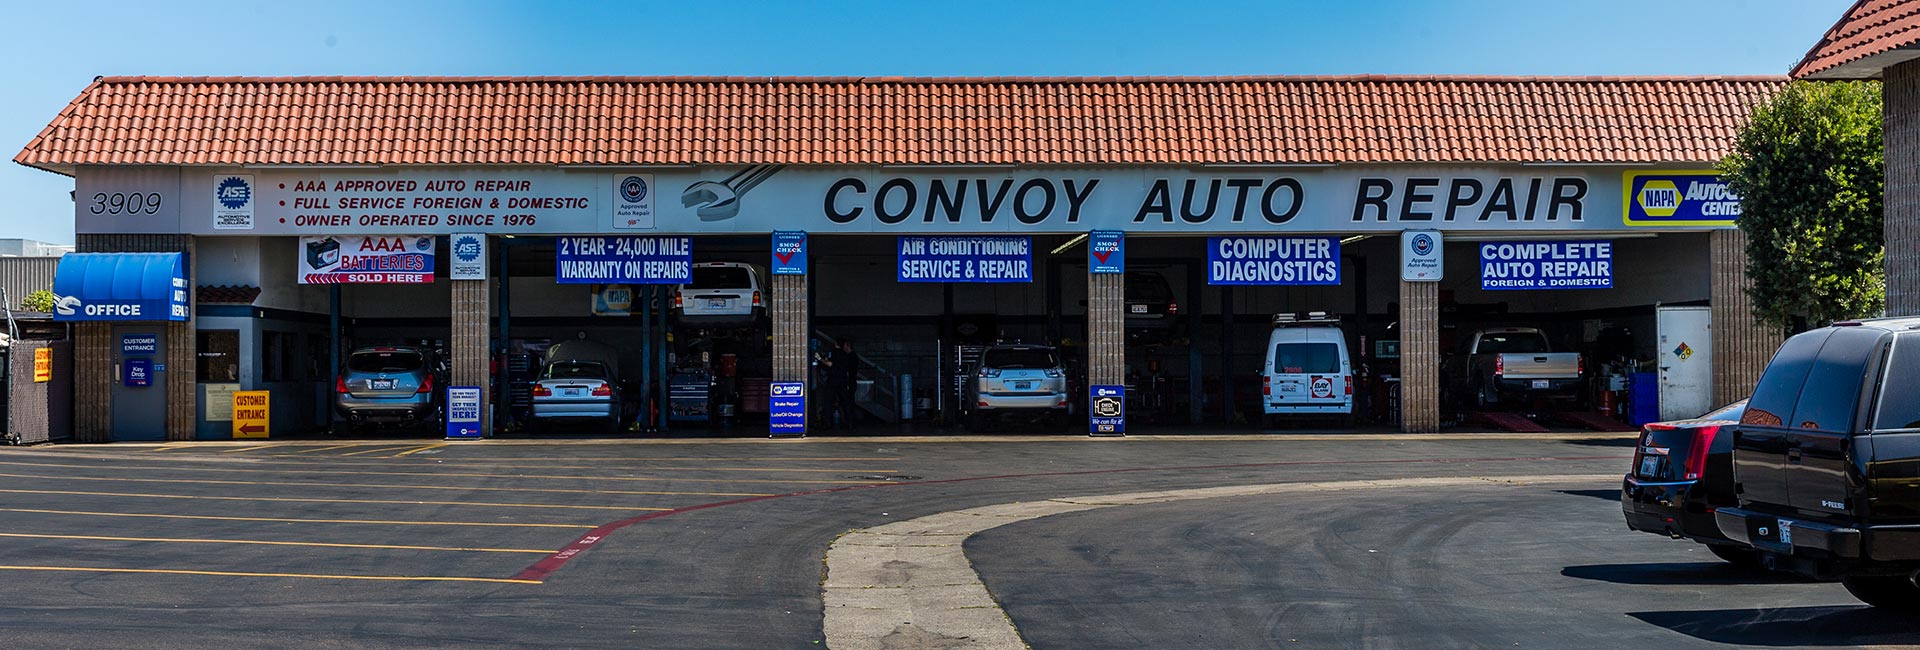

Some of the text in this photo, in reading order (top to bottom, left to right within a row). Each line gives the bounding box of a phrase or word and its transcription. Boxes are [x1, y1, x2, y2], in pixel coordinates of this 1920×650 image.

[221, 186, 246, 198] ASE
[294, 180, 531, 192] AAA APPROVED AUTO REPAIR
[90, 192, 162, 215] 3909
[294, 197, 589, 209] FULL SERVICE FOREIGN & DOMESTIC
[823, 177, 1589, 225] CONVOY AUTO REPAIR
[1645, 190, 1675, 207] NAPA
[294, 214, 536, 226] OWNER OPERATED SINCE 1976
[359, 236, 407, 252] AAA
[458, 243, 477, 253] ASE
[561, 237, 569, 255] 2
[572, 237, 605, 255] YEAR
[616, 237, 656, 259] 24,000
[659, 237, 689, 256] MILE
[902, 237, 1028, 255] AIR CONDITIONING
[1219, 238, 1331, 259] COMPUTER
[1481, 243, 1611, 260] COMPLETE
[341, 255, 425, 271] BATTERIES
[561, 260, 689, 279] WARRANTY ON REPAIRS
[902, 259, 1028, 279] SERVICE & REPAIR
[1213, 261, 1337, 281] DIAGNOSTICS
[1483, 261, 1610, 278] AUTO REPAIR
[348, 274, 423, 283] SOLD HERE
[174, 289, 187, 302] AUTO
[608, 290, 630, 303] NAPA
[84, 304, 141, 316] OFFICE
[171, 304, 189, 318] REPAIR
[236, 395, 266, 406] CUSTOMER
[236, 409, 266, 420] ENTRANCE
